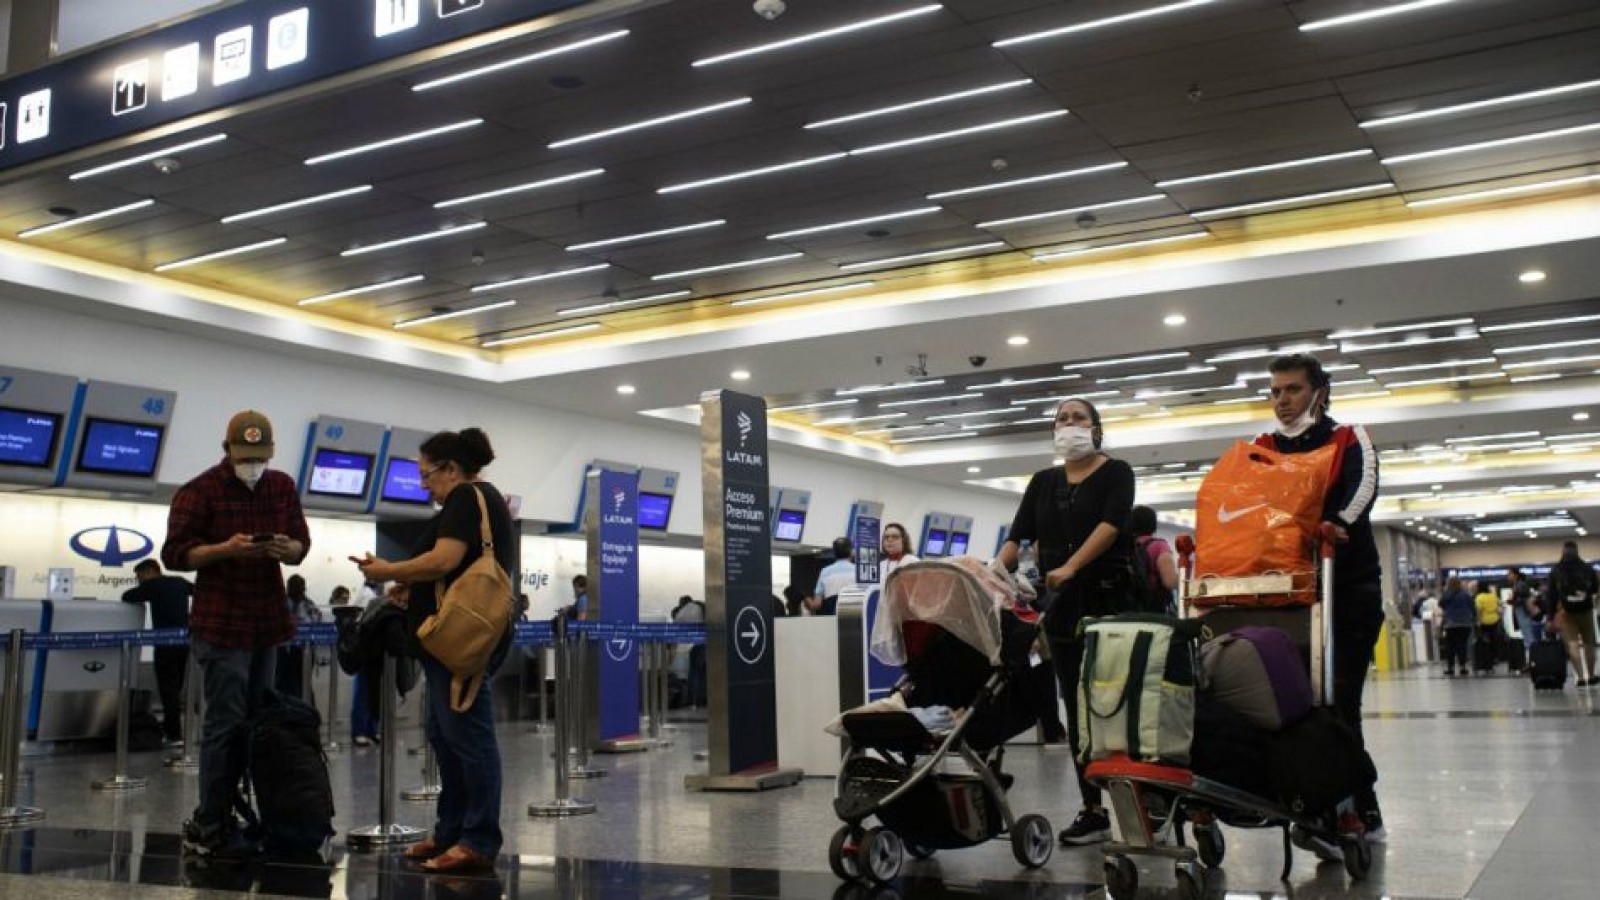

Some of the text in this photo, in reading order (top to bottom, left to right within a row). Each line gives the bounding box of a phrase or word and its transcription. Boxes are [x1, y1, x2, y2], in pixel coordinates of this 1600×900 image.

[142, 397, 164, 415] 48
[325, 424, 344, 440] 49
[726, 451, 762, 467] LATAM
[726, 487, 756, 505] Acceso
[603, 514, 633, 526] LATAM
[726, 504, 764, 521] Premium
